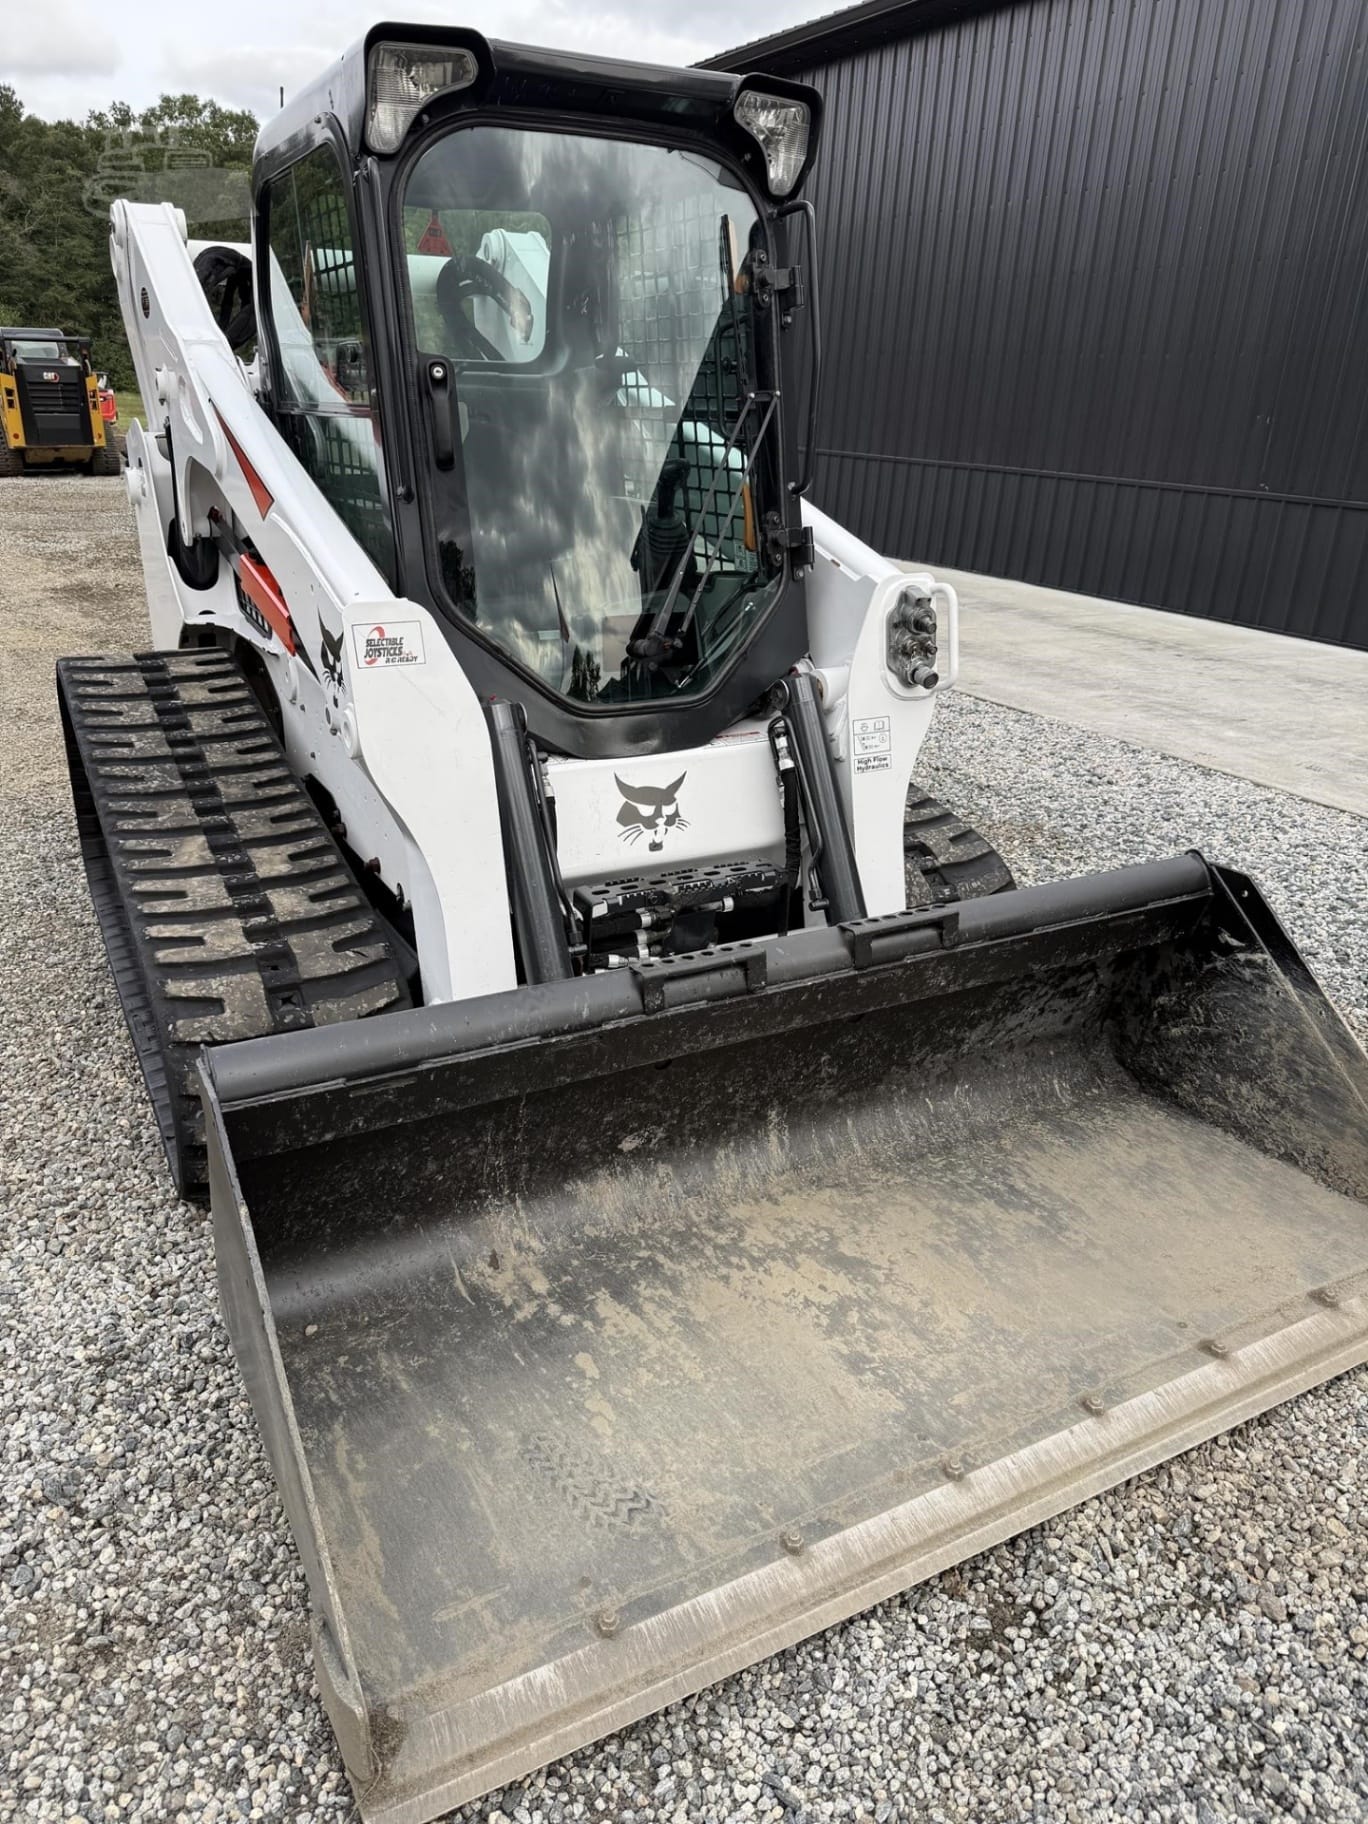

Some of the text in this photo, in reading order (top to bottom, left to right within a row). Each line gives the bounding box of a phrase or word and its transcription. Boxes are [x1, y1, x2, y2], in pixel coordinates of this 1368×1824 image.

[43, 371, 55, 380] CAT
[365, 637, 404, 648] SELECTABLE
[364, 646, 403, 658] JOYSTICKS
[856, 762, 889, 773] Hydraulics
